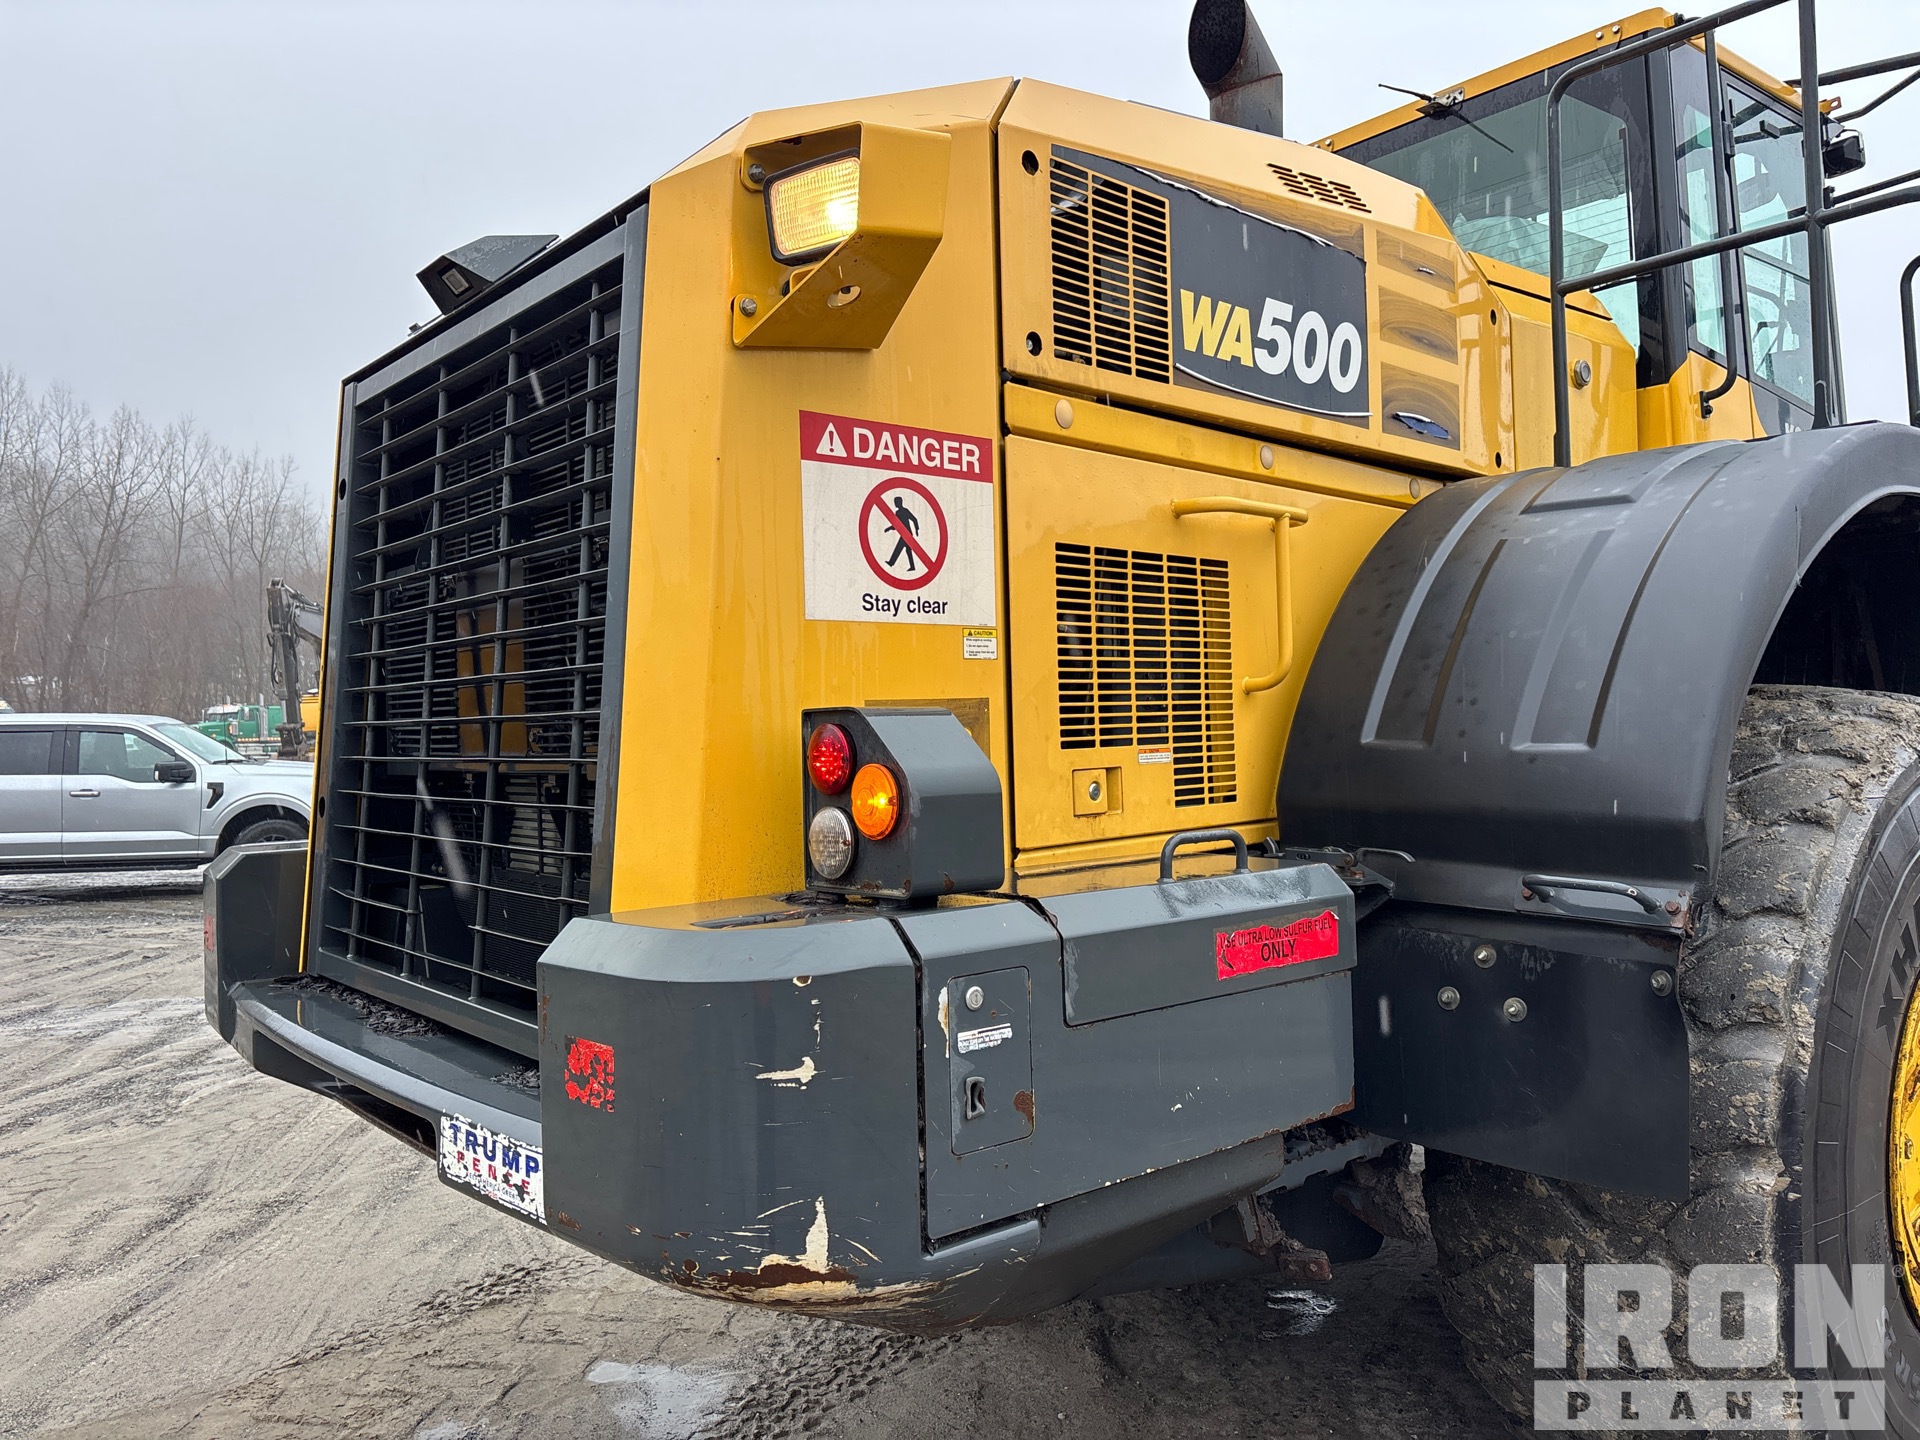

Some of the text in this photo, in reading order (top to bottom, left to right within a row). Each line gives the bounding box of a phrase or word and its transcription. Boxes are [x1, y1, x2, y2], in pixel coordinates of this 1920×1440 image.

[1180, 288, 1362, 394] WA500
[853, 426, 981, 474] DANGER
[862, 592, 948, 617] Stay clear
[973, 629, 993, 637] CAUTION
[1220, 918, 1332, 949] USE ULTRA LOW SULFUR FUEL
[1260, 938, 1297, 962] ONLY
[449, 1122, 540, 1178] TRUMP
